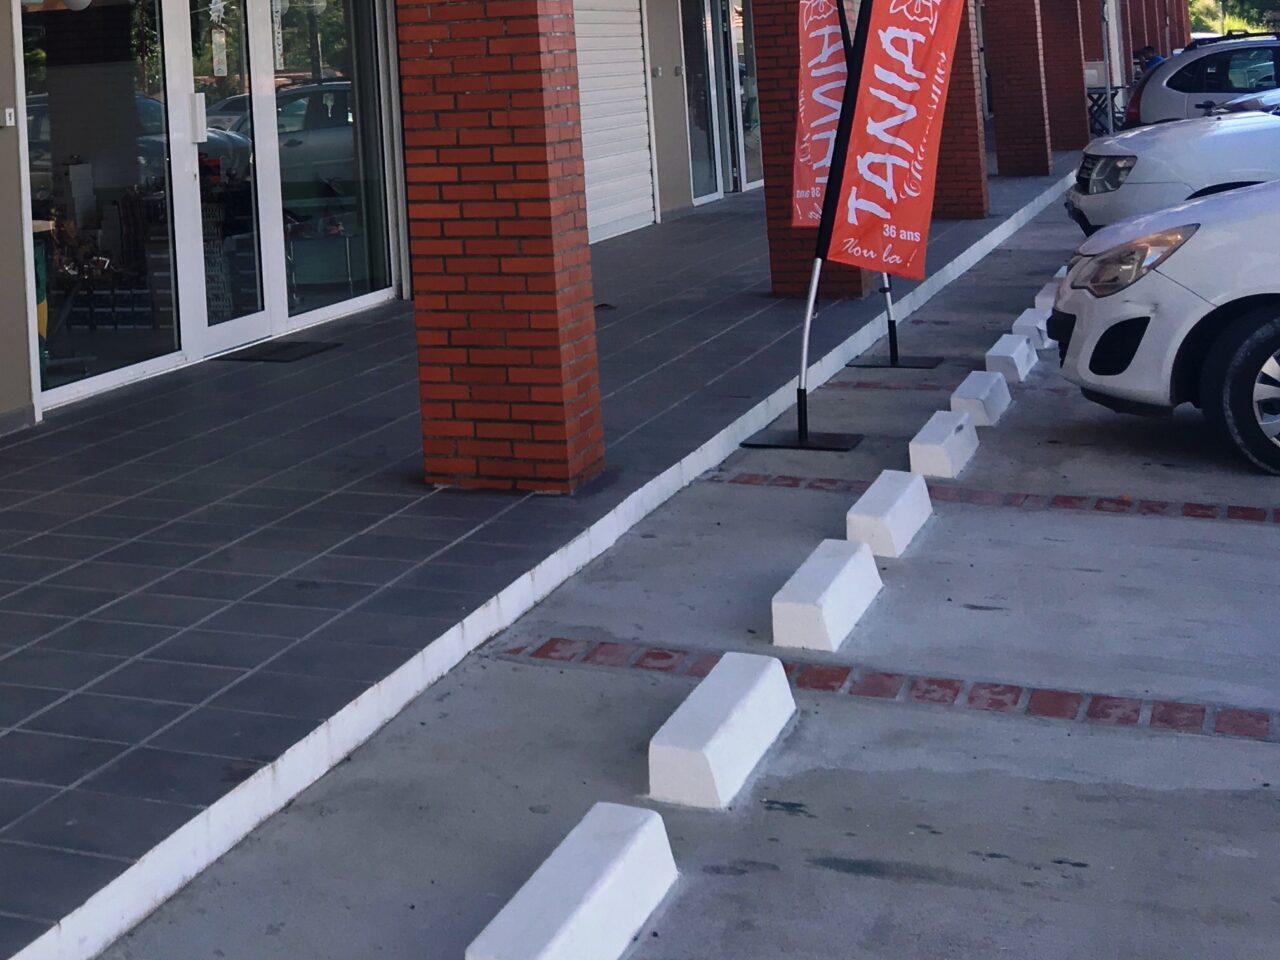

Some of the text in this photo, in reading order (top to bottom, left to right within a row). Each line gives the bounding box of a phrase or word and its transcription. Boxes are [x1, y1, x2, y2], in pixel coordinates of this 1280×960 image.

[847, 26, 926, 226] TANIA
[883, 223, 921, 242] 36 ans
